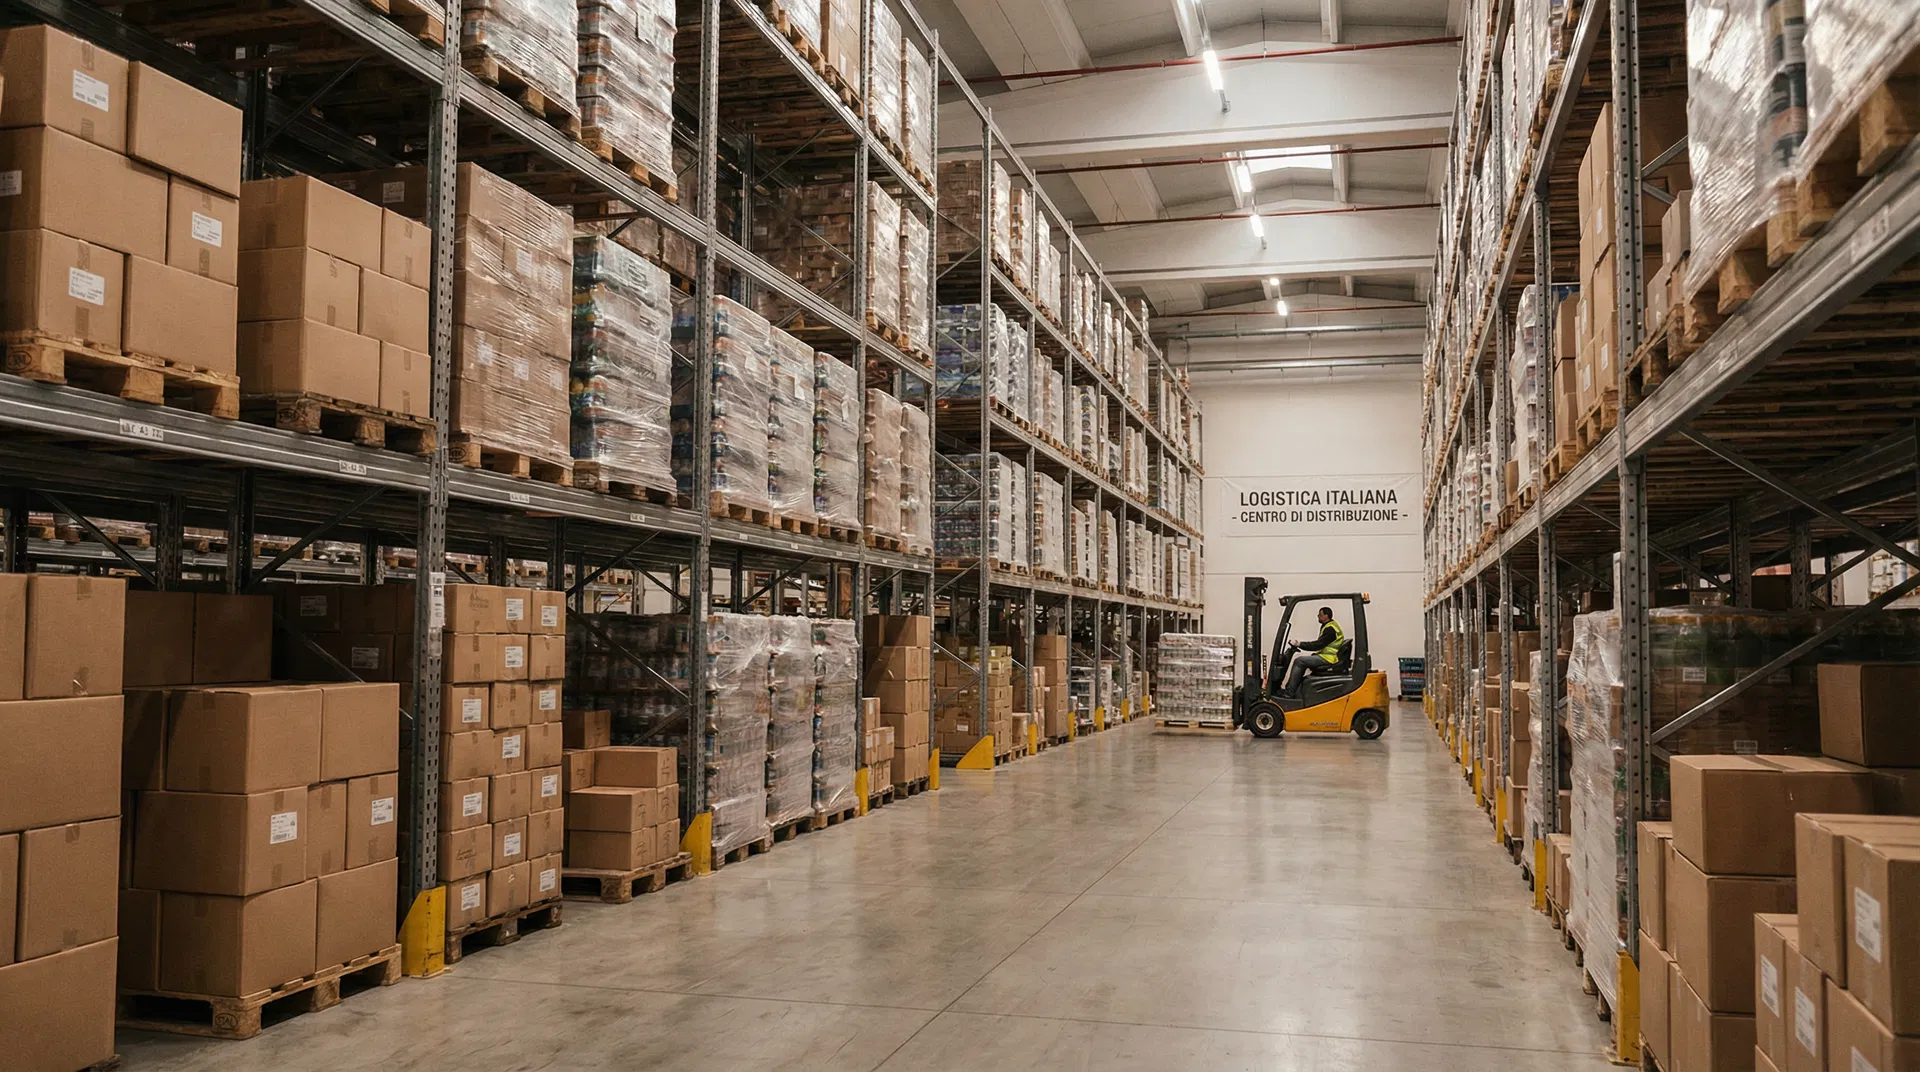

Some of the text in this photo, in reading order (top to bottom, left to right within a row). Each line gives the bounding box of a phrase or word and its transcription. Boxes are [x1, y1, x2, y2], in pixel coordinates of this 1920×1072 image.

[1240, 489, 1398, 506] LOGISTICA ITALIANA
[1240, 510, 1287, 522] CENTRO
[1290, 510, 1303, 522] DI
[1306, 509, 1398, 522] DISTRIBUZIONE
